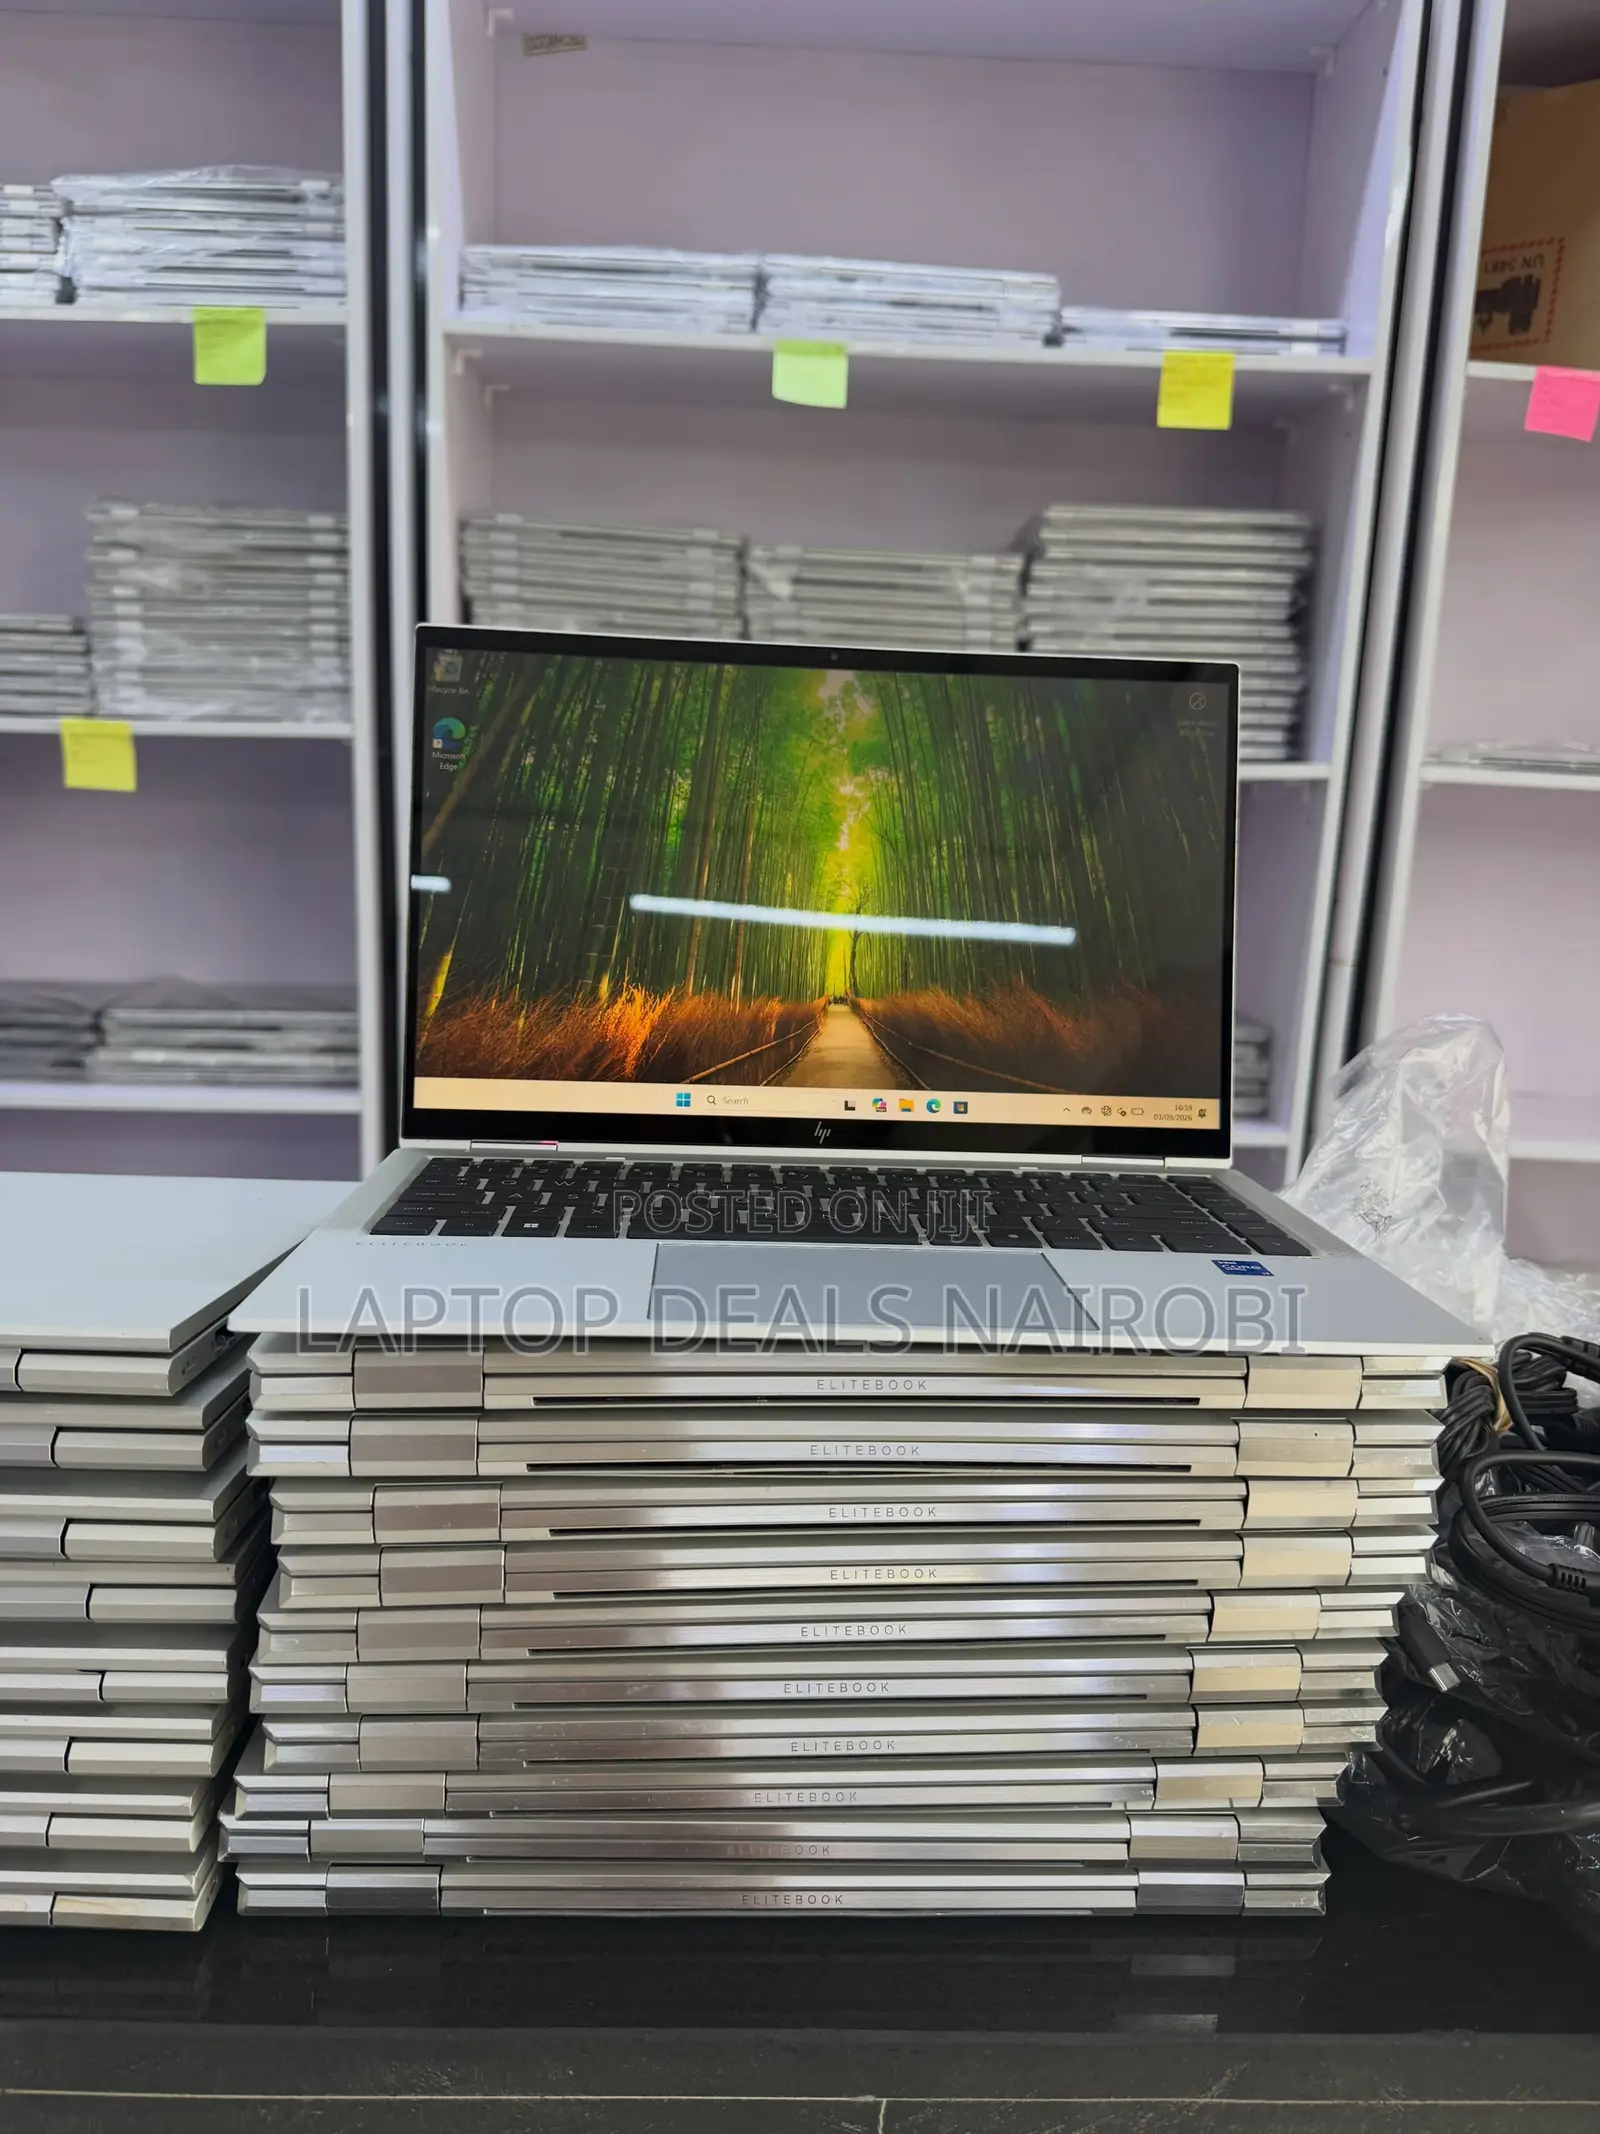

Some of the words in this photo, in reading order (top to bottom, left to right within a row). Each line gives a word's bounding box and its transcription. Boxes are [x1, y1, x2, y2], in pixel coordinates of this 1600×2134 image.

[432, 752, 466, 760] Microsoft
[440, 763, 458, 771] Edge
[722, 1096, 749, 1105] Search
[1174, 1104, 1193, 1112] 16:59
[814, 1121, 832, 1145] hp
[816, 1379, 927, 1391] ELITEBOOK
[809, 1444, 920, 1456] ELITEBOOK
[828, 1506, 937, 1518] ELITEBOOK
[829, 1568, 937, 1580] ELITEBOOK
[800, 1624, 908, 1637] ELITEBOOK
[783, 1681, 890, 1694] ELITEBOOK
[790, 1739, 896, 1752] ELITEBOOK
[753, 1791, 858, 1803] ELITEBOOK
[726, 1845, 831, 1856] ELITEBOOK
[741, 1894, 844, 1906] ELITEBOOK
